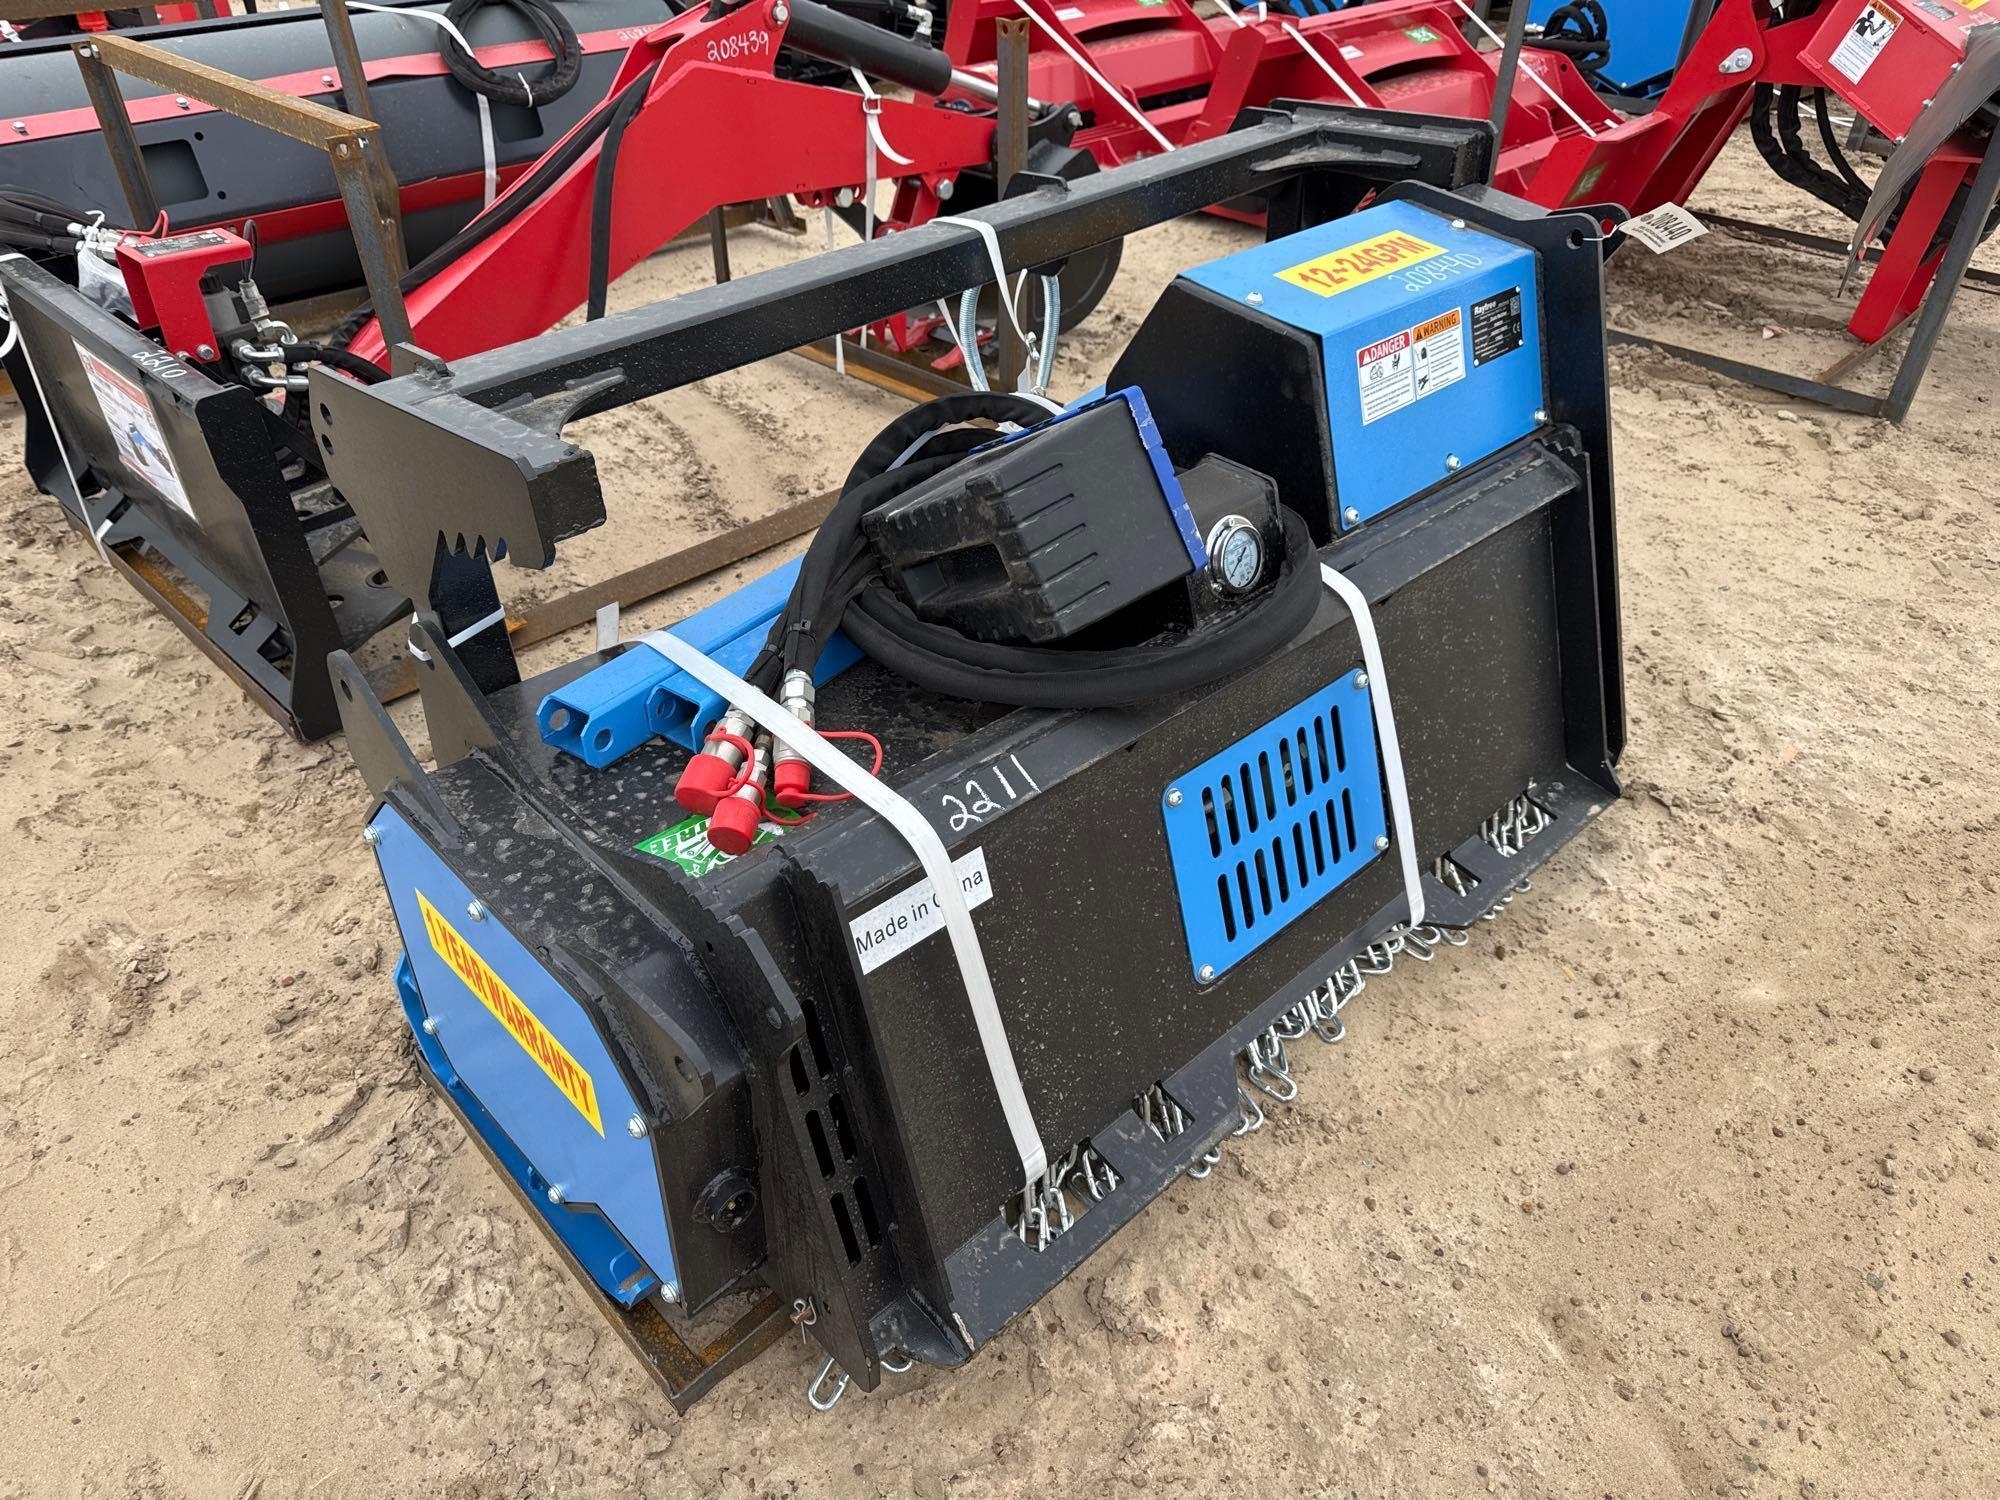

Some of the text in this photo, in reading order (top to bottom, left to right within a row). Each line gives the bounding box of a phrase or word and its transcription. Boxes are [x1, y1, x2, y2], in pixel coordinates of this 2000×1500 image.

[706, 30, 769, 62] 208439
[1388, 253, 1483, 292] 208440
[1474, 301, 1497, 315] Raytree
[1423, 313, 1457, 338] WARNING
[1370, 334, 1406, 360] DANGER
[132, 350, 187, 378] 2210
[941, 754, 1042, 832] 2211
[855, 915, 908, 955] Made
[911, 903, 929, 922] in
[425, 908, 591, 1114] 1 YEAR WARRANTY
